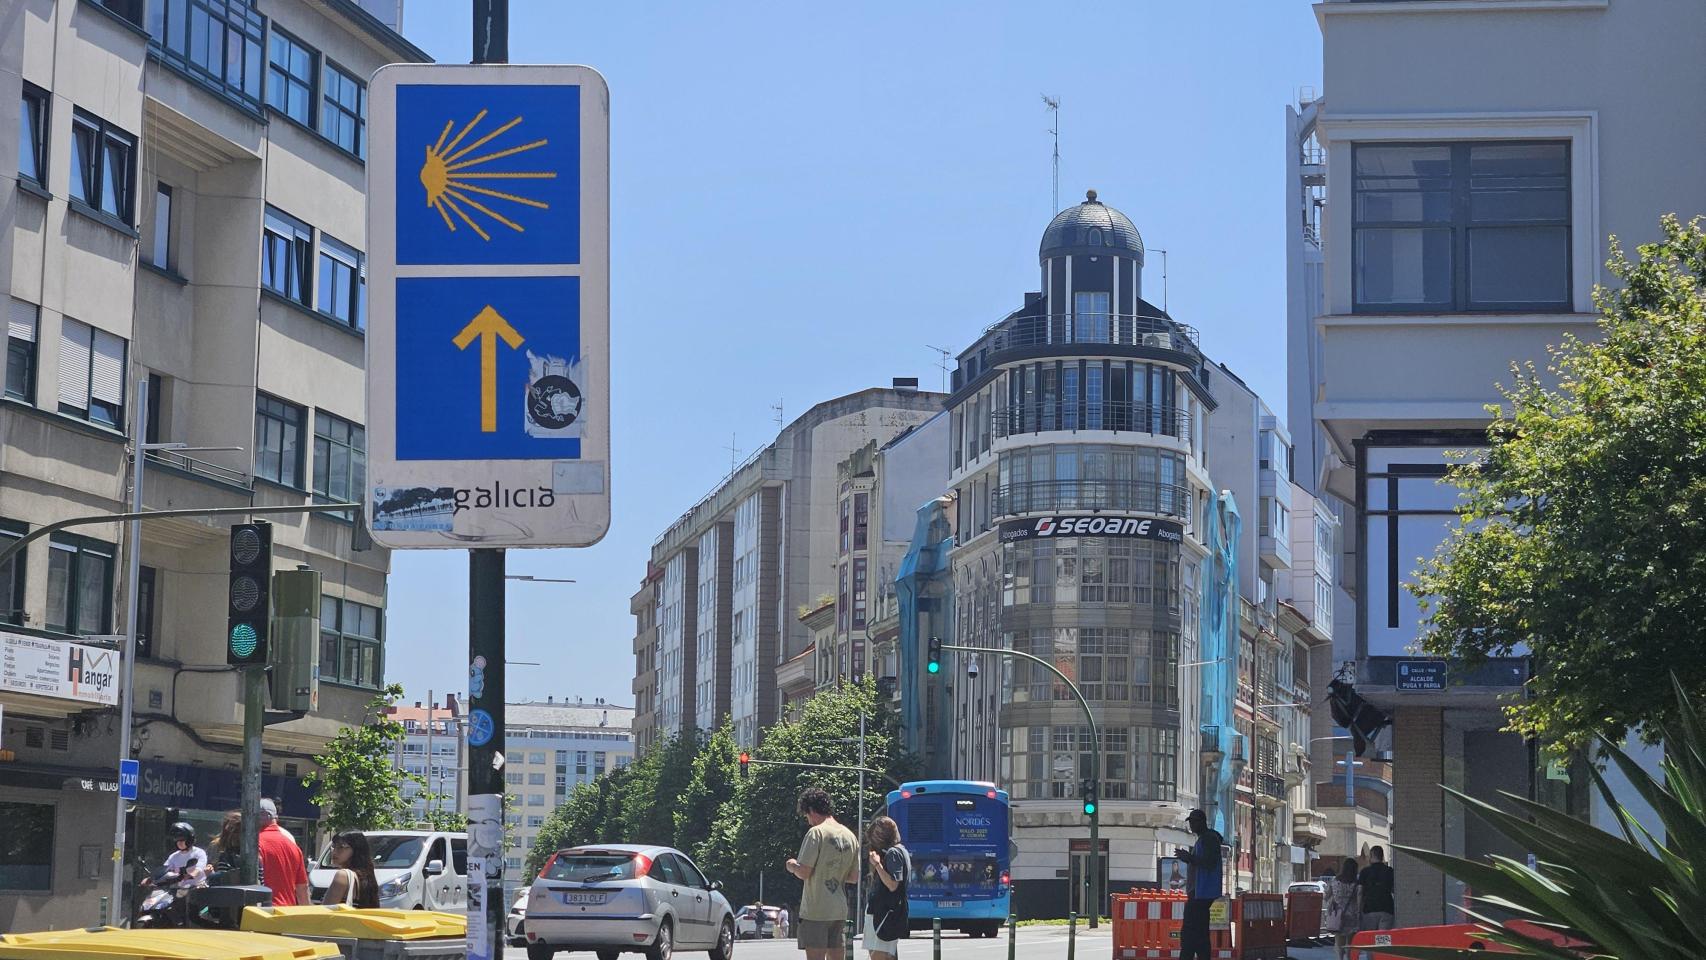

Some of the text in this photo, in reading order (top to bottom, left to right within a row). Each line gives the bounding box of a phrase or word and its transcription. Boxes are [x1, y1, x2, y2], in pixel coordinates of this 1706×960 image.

[453, 481, 555, 515] galicia
[68, 646, 112, 691] Hangar
[122, 773, 137, 786] TAXI
